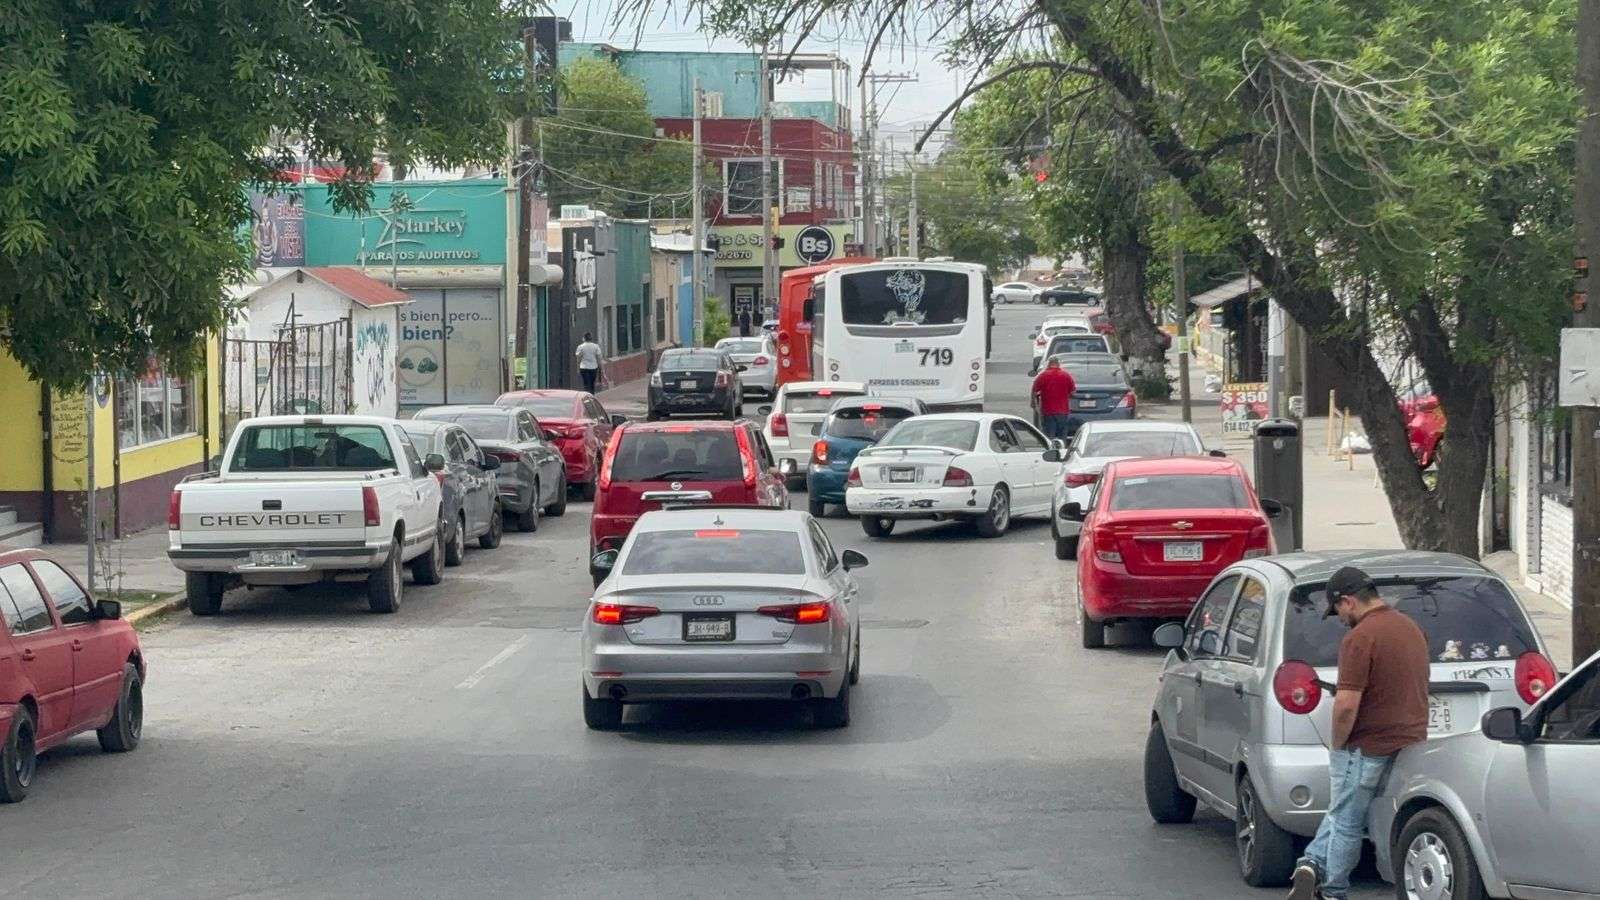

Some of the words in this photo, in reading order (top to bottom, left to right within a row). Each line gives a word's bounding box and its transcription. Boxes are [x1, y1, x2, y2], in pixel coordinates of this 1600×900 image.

[395, 215, 467, 237] Starkey
[735, 233, 746, 245] &
[801, 236, 829, 253] Bs
[355, 251, 414, 261] APARATOS
[417, 250, 480, 261] AUDITIVOS
[715, 249, 752, 260] 0.2670
[402, 326, 454, 341] bien?
[917, 347, 954, 367] 719
[200, 513, 347, 527] CHEVROLET
